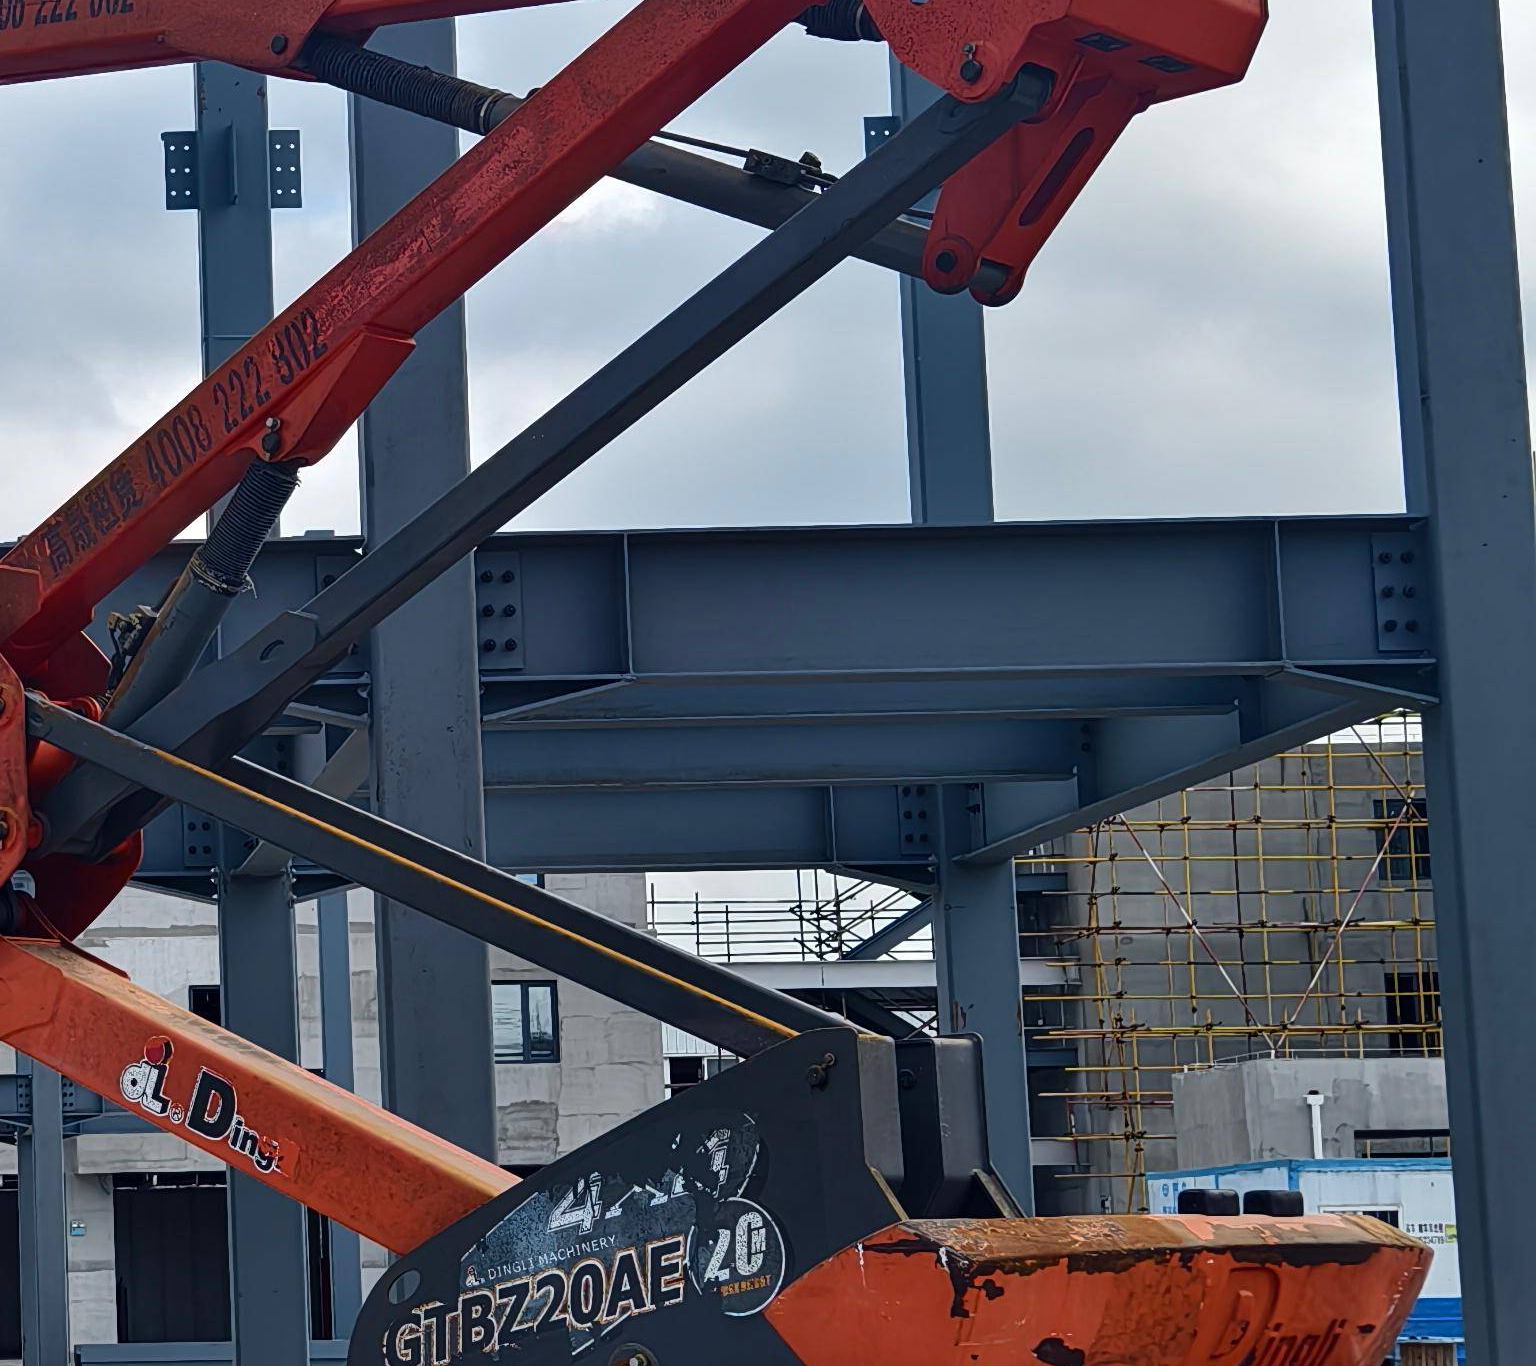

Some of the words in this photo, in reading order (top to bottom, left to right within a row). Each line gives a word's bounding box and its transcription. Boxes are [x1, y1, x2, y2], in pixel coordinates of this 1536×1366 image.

[143, 403, 214, 487] 4008
[213, 355, 272, 434] 222
[487, 1259, 534, 1281] DINGLI
[537, 1235, 616, 1269] MACHINERY
